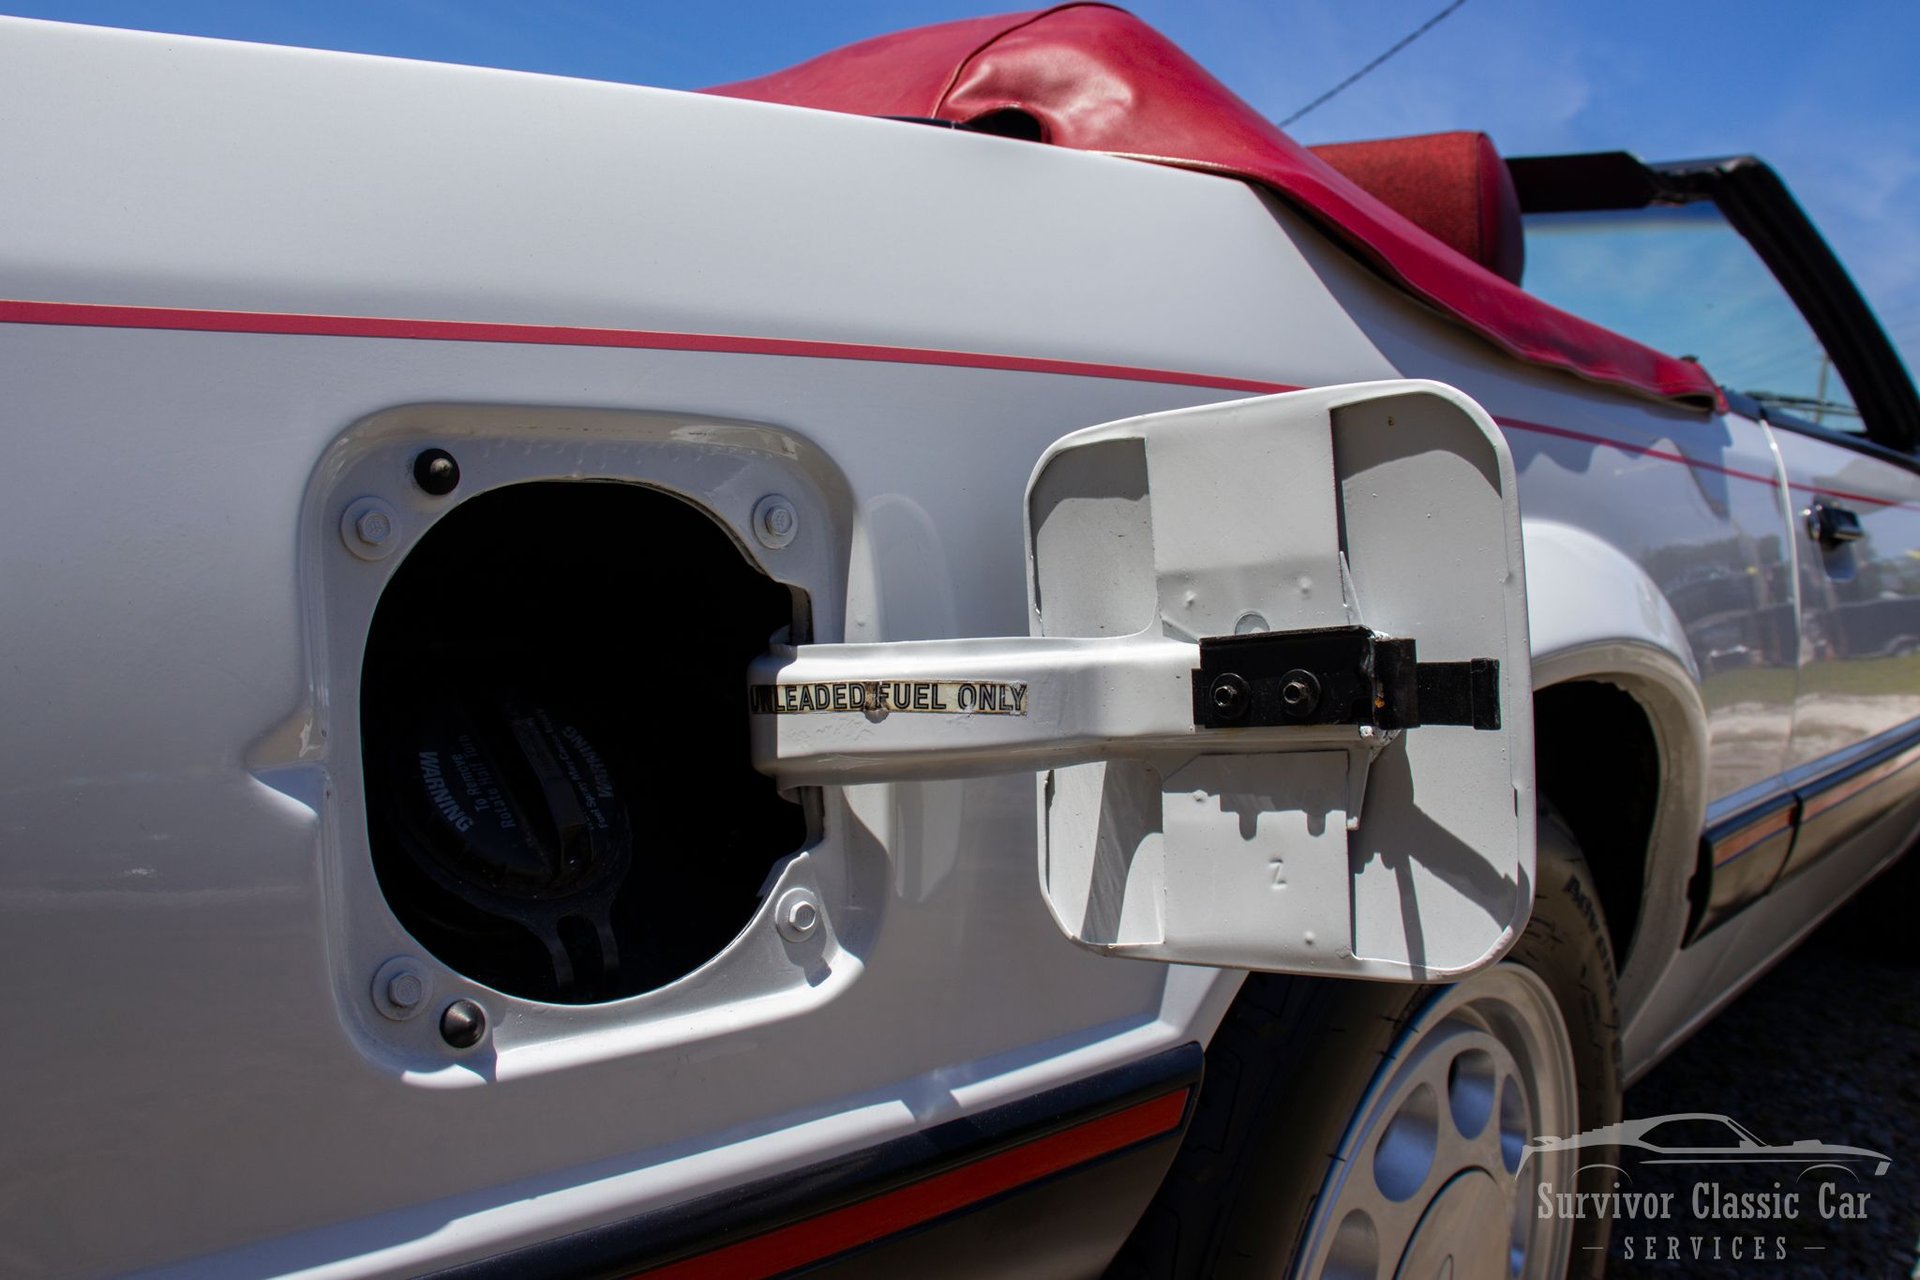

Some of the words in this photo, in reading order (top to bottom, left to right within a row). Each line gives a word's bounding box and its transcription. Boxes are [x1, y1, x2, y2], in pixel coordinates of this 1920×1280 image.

[751, 683, 866, 712] UNLEADED
[876, 683, 947, 710] FUEL
[957, 683, 1027, 711] ONLY
[451, 753, 481, 796] Remove
[561, 725, 614, 799] WARNING
[418, 751, 474, 832] WARNING
[473, 798, 490, 812] To
